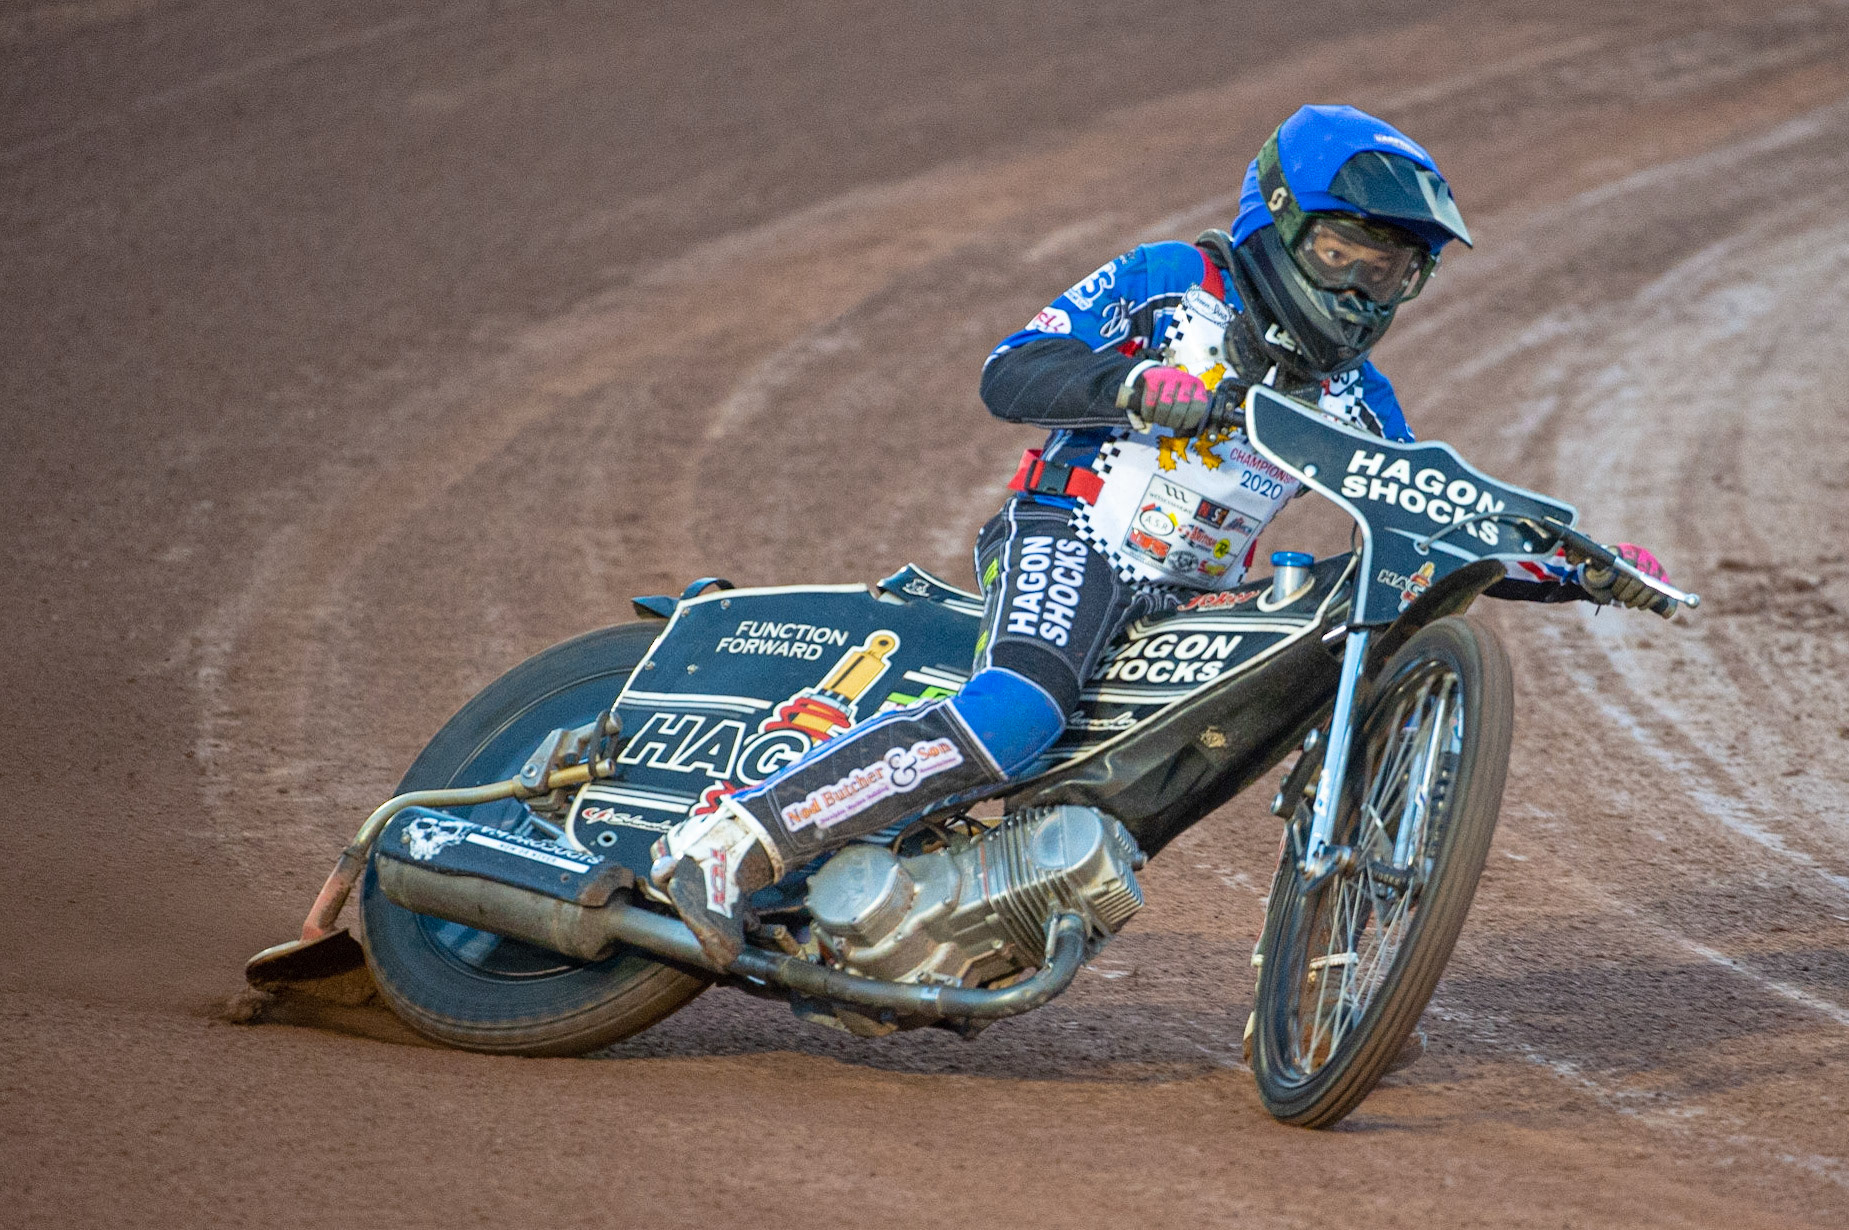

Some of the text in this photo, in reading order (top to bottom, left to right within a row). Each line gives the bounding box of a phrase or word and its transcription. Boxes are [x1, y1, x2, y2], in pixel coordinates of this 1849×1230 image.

[1240, 470, 1283, 500] 2020
[1341, 475, 1500, 546] SHOCKS
[1346, 450, 1506, 520] HAGON
[1007, 535, 1054, 635] HAGON
[1039, 538, 1089, 647] SHOCKS
[1376, 569, 1428, 594] HAG
[715, 637, 823, 661] FORWARD
[735, 620, 849, 646] FUNCTION
[1093, 659, 1224, 683] HOCKS
[617, 712, 812, 785] HAG
[821, 766, 884, 807] Butcher
[888, 753, 918, 787] &
[916, 742, 952, 762] Son
